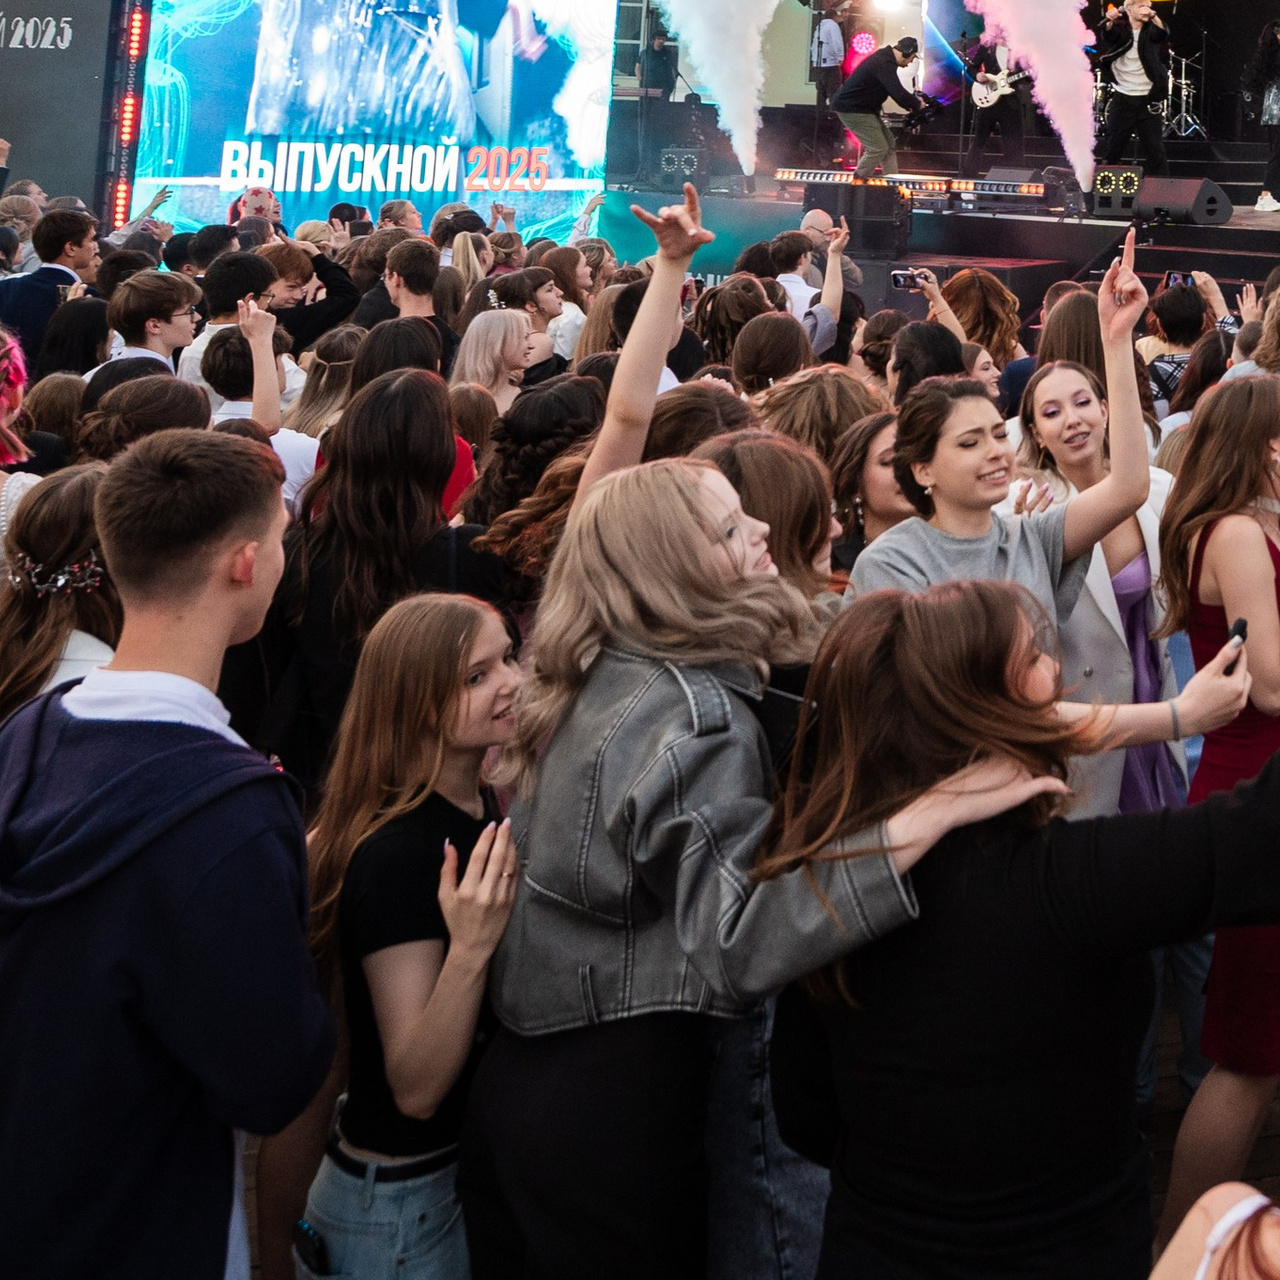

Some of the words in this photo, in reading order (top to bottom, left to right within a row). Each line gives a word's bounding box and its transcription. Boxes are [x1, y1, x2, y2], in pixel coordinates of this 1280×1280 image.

[9, 16, 73, 50] 2025
[219, 135, 460, 192] ВЫПУСКНОЙ
[465, 145, 548, 192] 2025
